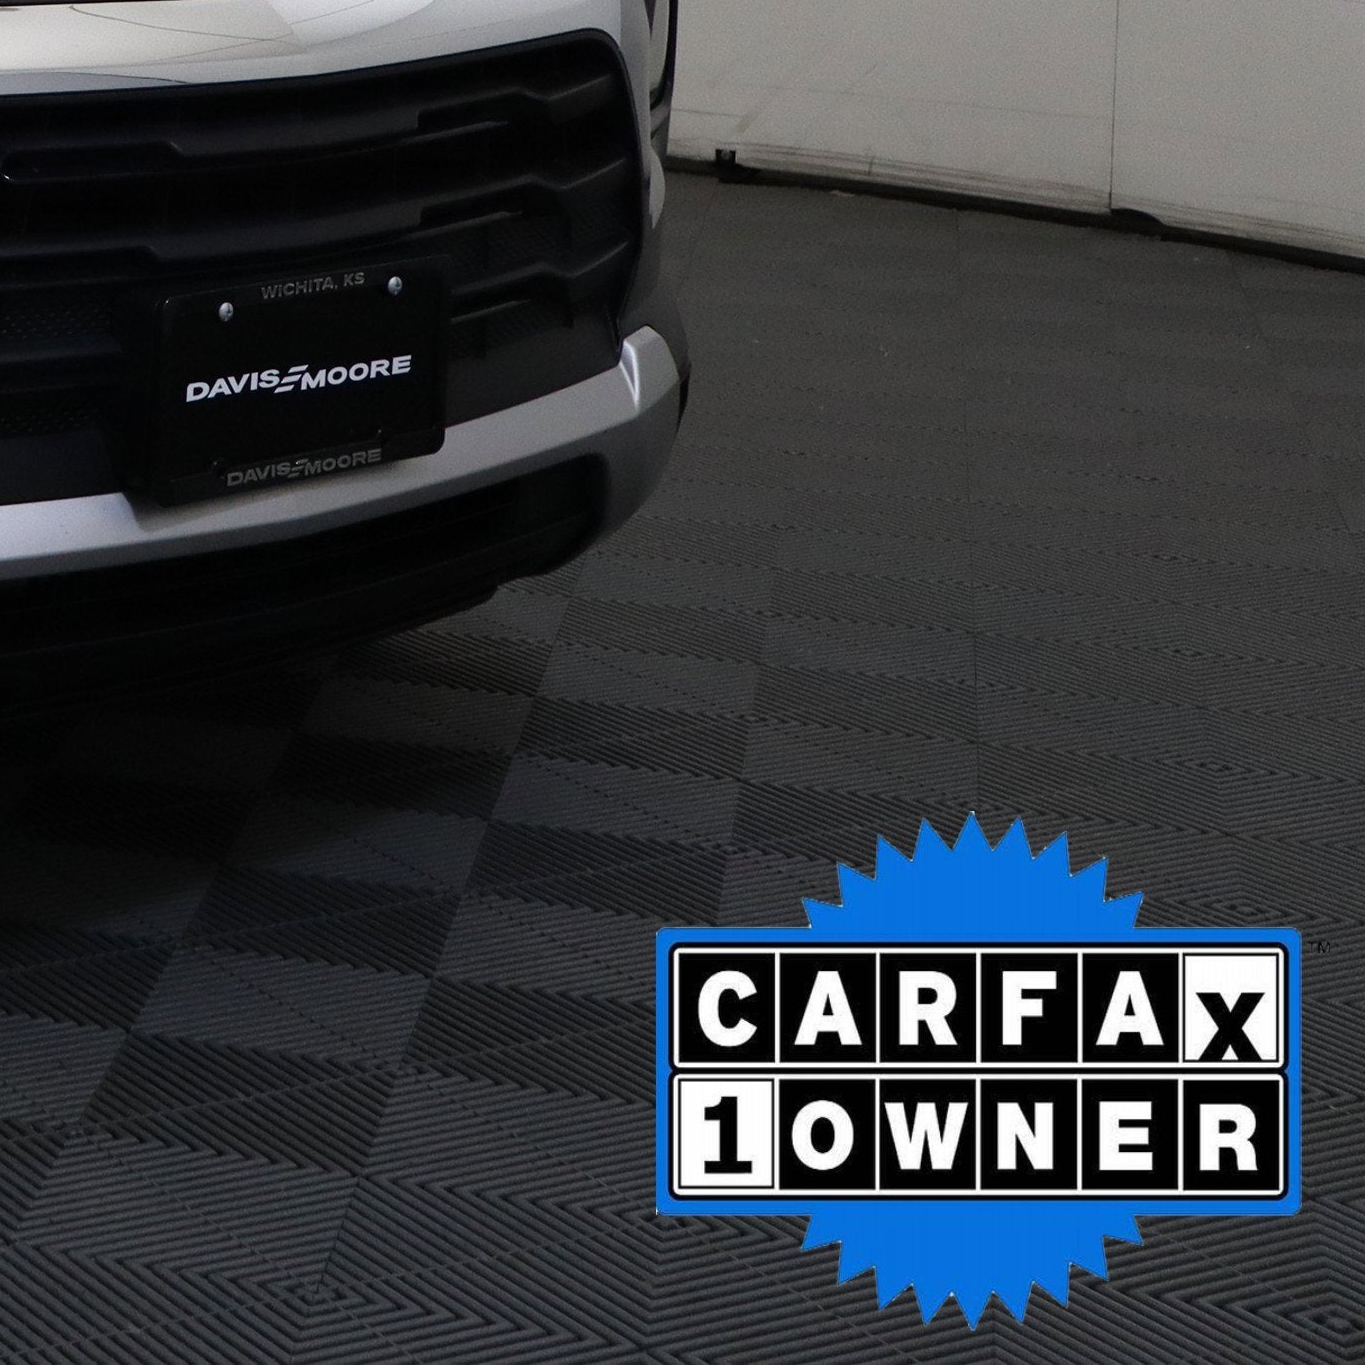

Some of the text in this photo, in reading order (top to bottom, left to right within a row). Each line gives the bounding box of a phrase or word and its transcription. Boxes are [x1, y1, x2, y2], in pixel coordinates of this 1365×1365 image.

[260, 272, 365, 300] WICHITA, KS
[186, 354, 412, 402] DAVIS MOORE
[226, 448, 382, 487] DAVIS MOORE
